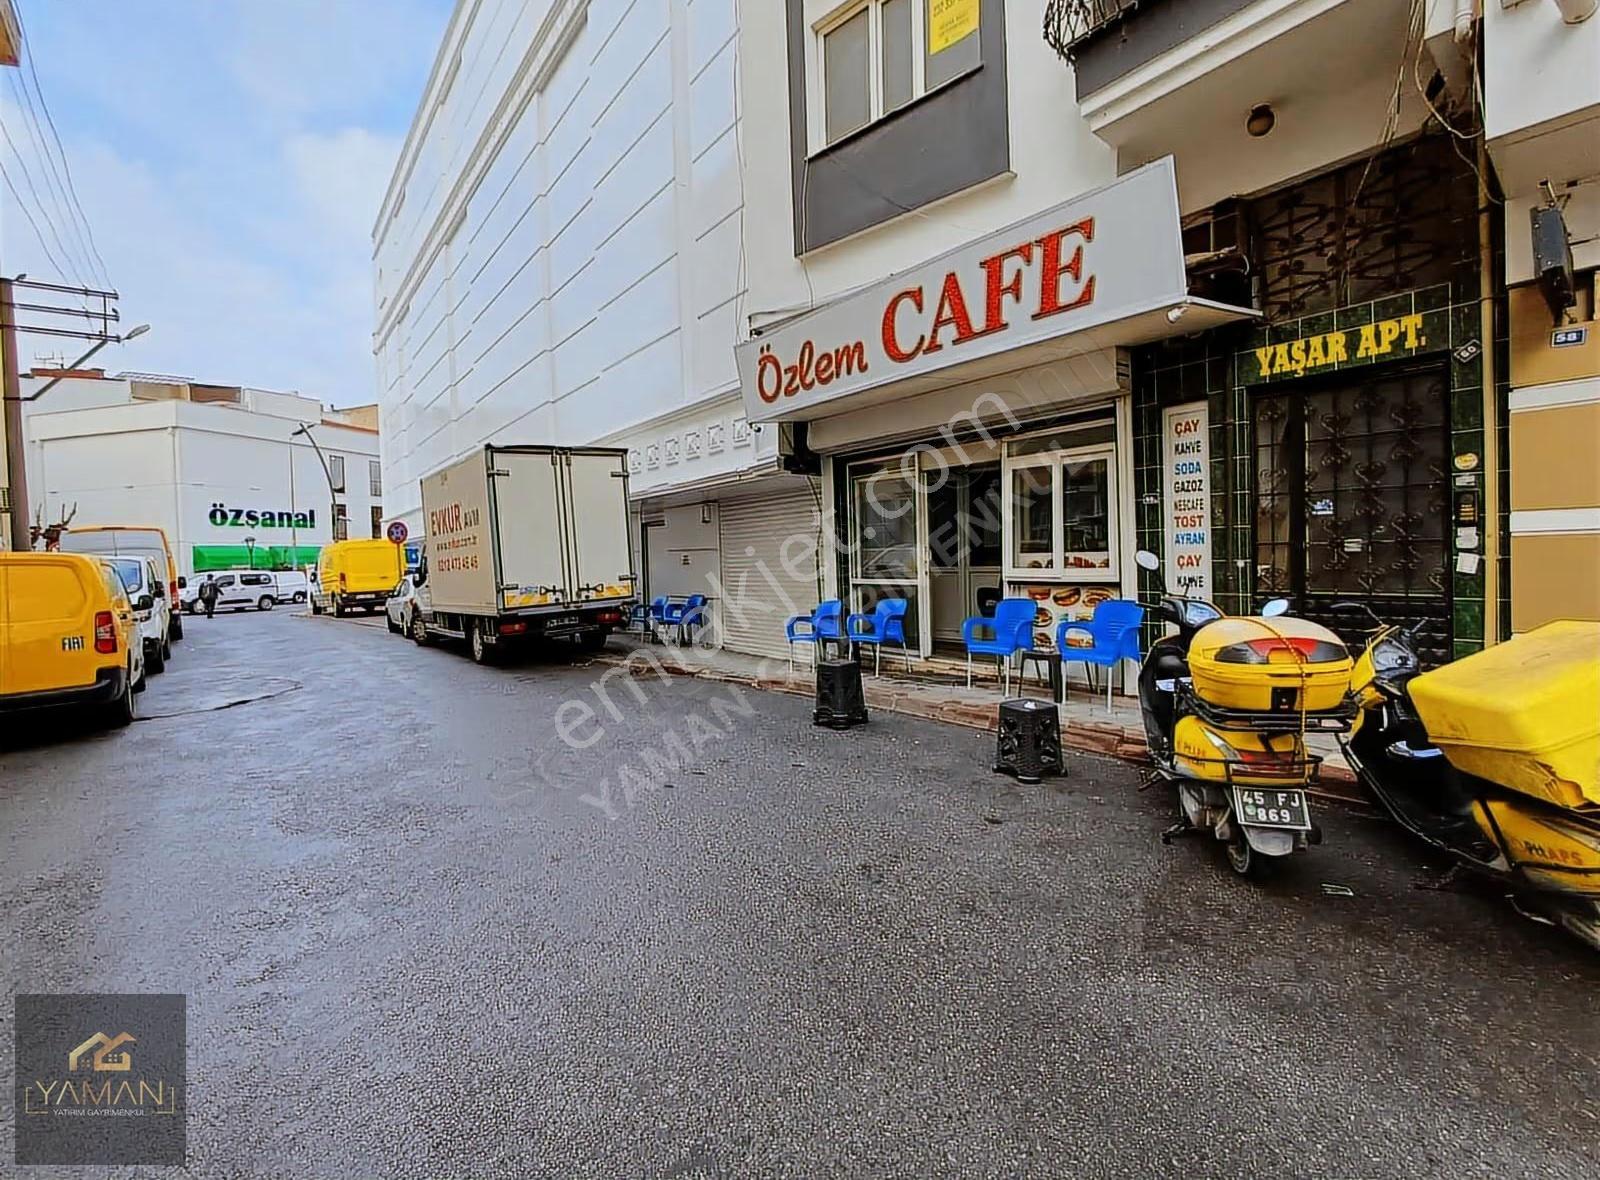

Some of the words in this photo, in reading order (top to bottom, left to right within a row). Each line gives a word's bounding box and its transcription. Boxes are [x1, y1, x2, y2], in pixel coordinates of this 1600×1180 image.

[757, 340, 869, 404] Özlem
[881, 215, 1097, 364] CAFE
[1255, 331, 1348, 378] YAŞAR
[1356, 314, 1427, 359] APT.
[1174, 419, 1200, 438] ÇAY
[1174, 440, 1201, 455] KAHVE
[1174, 461, 1202, 475] SODA
[1173, 479, 1204, 493] GAZOZ
[1174, 498, 1204, 511] NESCAFE
[430, 503, 463, 537] EVKUR
[1173, 515, 1204, 528] TOST
[1174, 532, 1205, 545] AYRAN
[1177, 554, 1202, 570] ÇAY
[1177, 575, 1204, 588] KAHVE
[61, 636, 85, 651] FIAT
[1242, 791, 1265, 805] 45
[1257, 809, 1290, 823] 869
